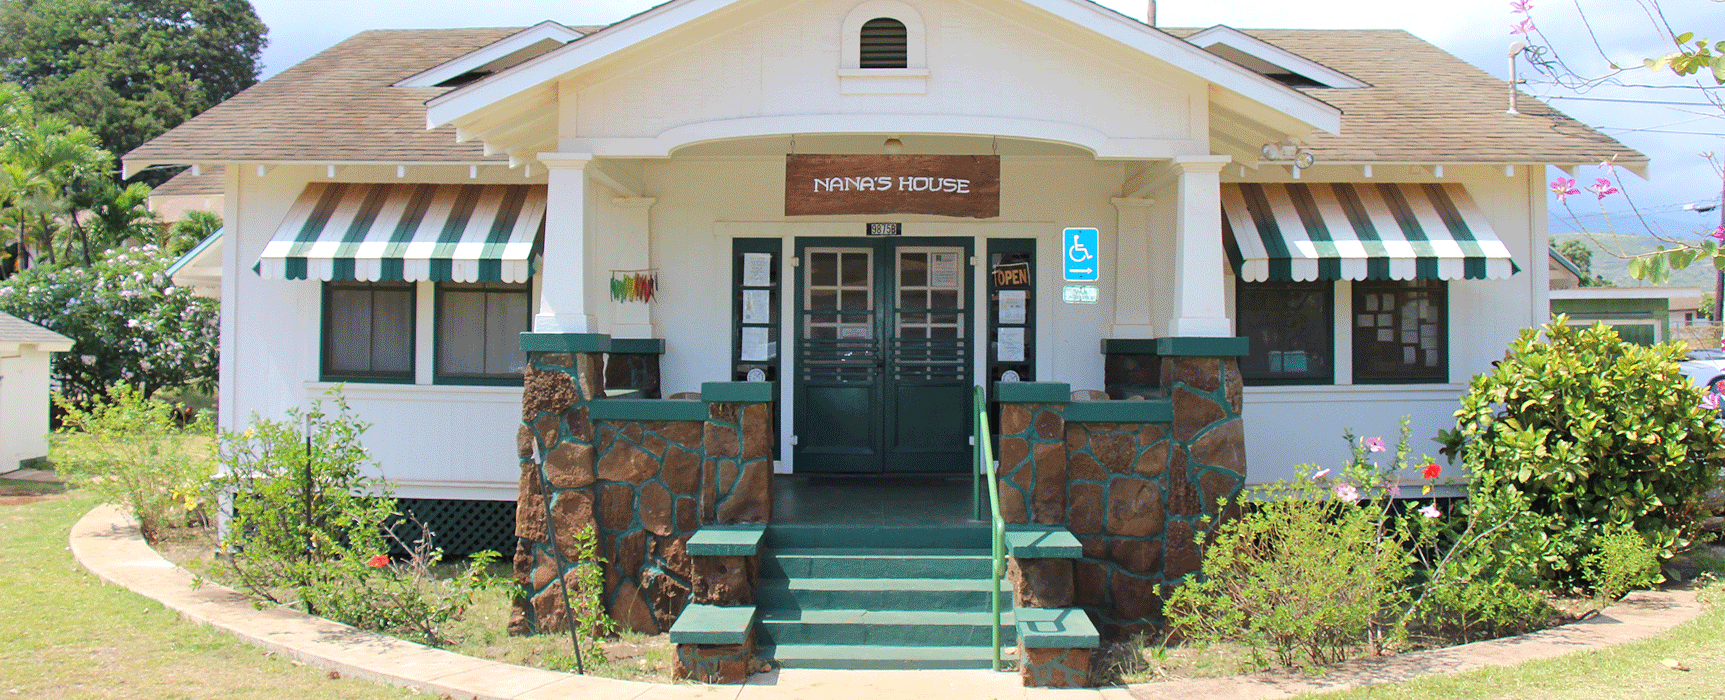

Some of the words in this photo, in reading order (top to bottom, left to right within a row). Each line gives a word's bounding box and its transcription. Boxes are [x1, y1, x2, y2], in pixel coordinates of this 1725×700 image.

[813, 176, 892, 193] NANA'S
[898, 176, 970, 194] HOUSE
[997, 269, 1028, 286] OPEN
